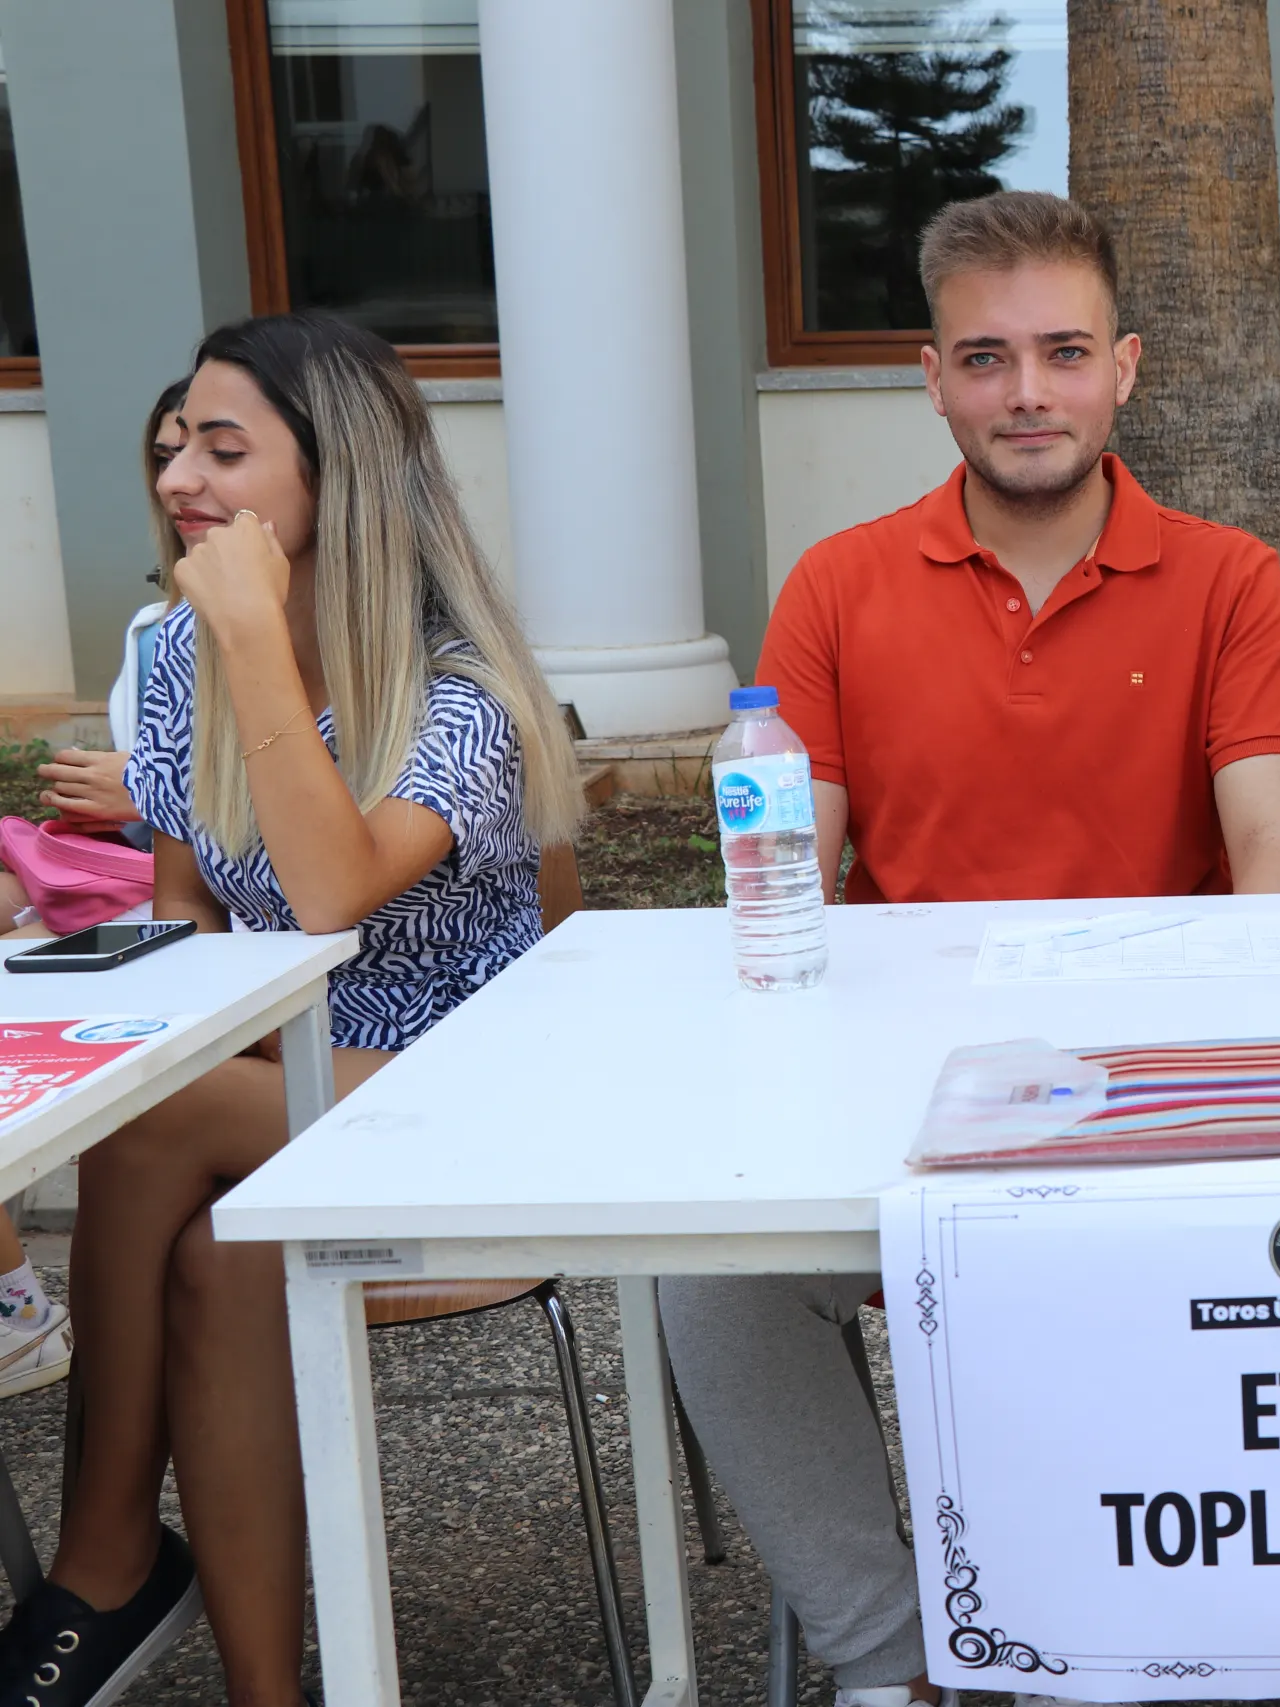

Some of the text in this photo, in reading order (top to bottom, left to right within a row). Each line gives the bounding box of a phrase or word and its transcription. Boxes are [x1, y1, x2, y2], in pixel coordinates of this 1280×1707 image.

[719, 796, 739, 809] Pure
[741, 795, 763, 812] Life
[1197, 1301, 1270, 1323] Toros
